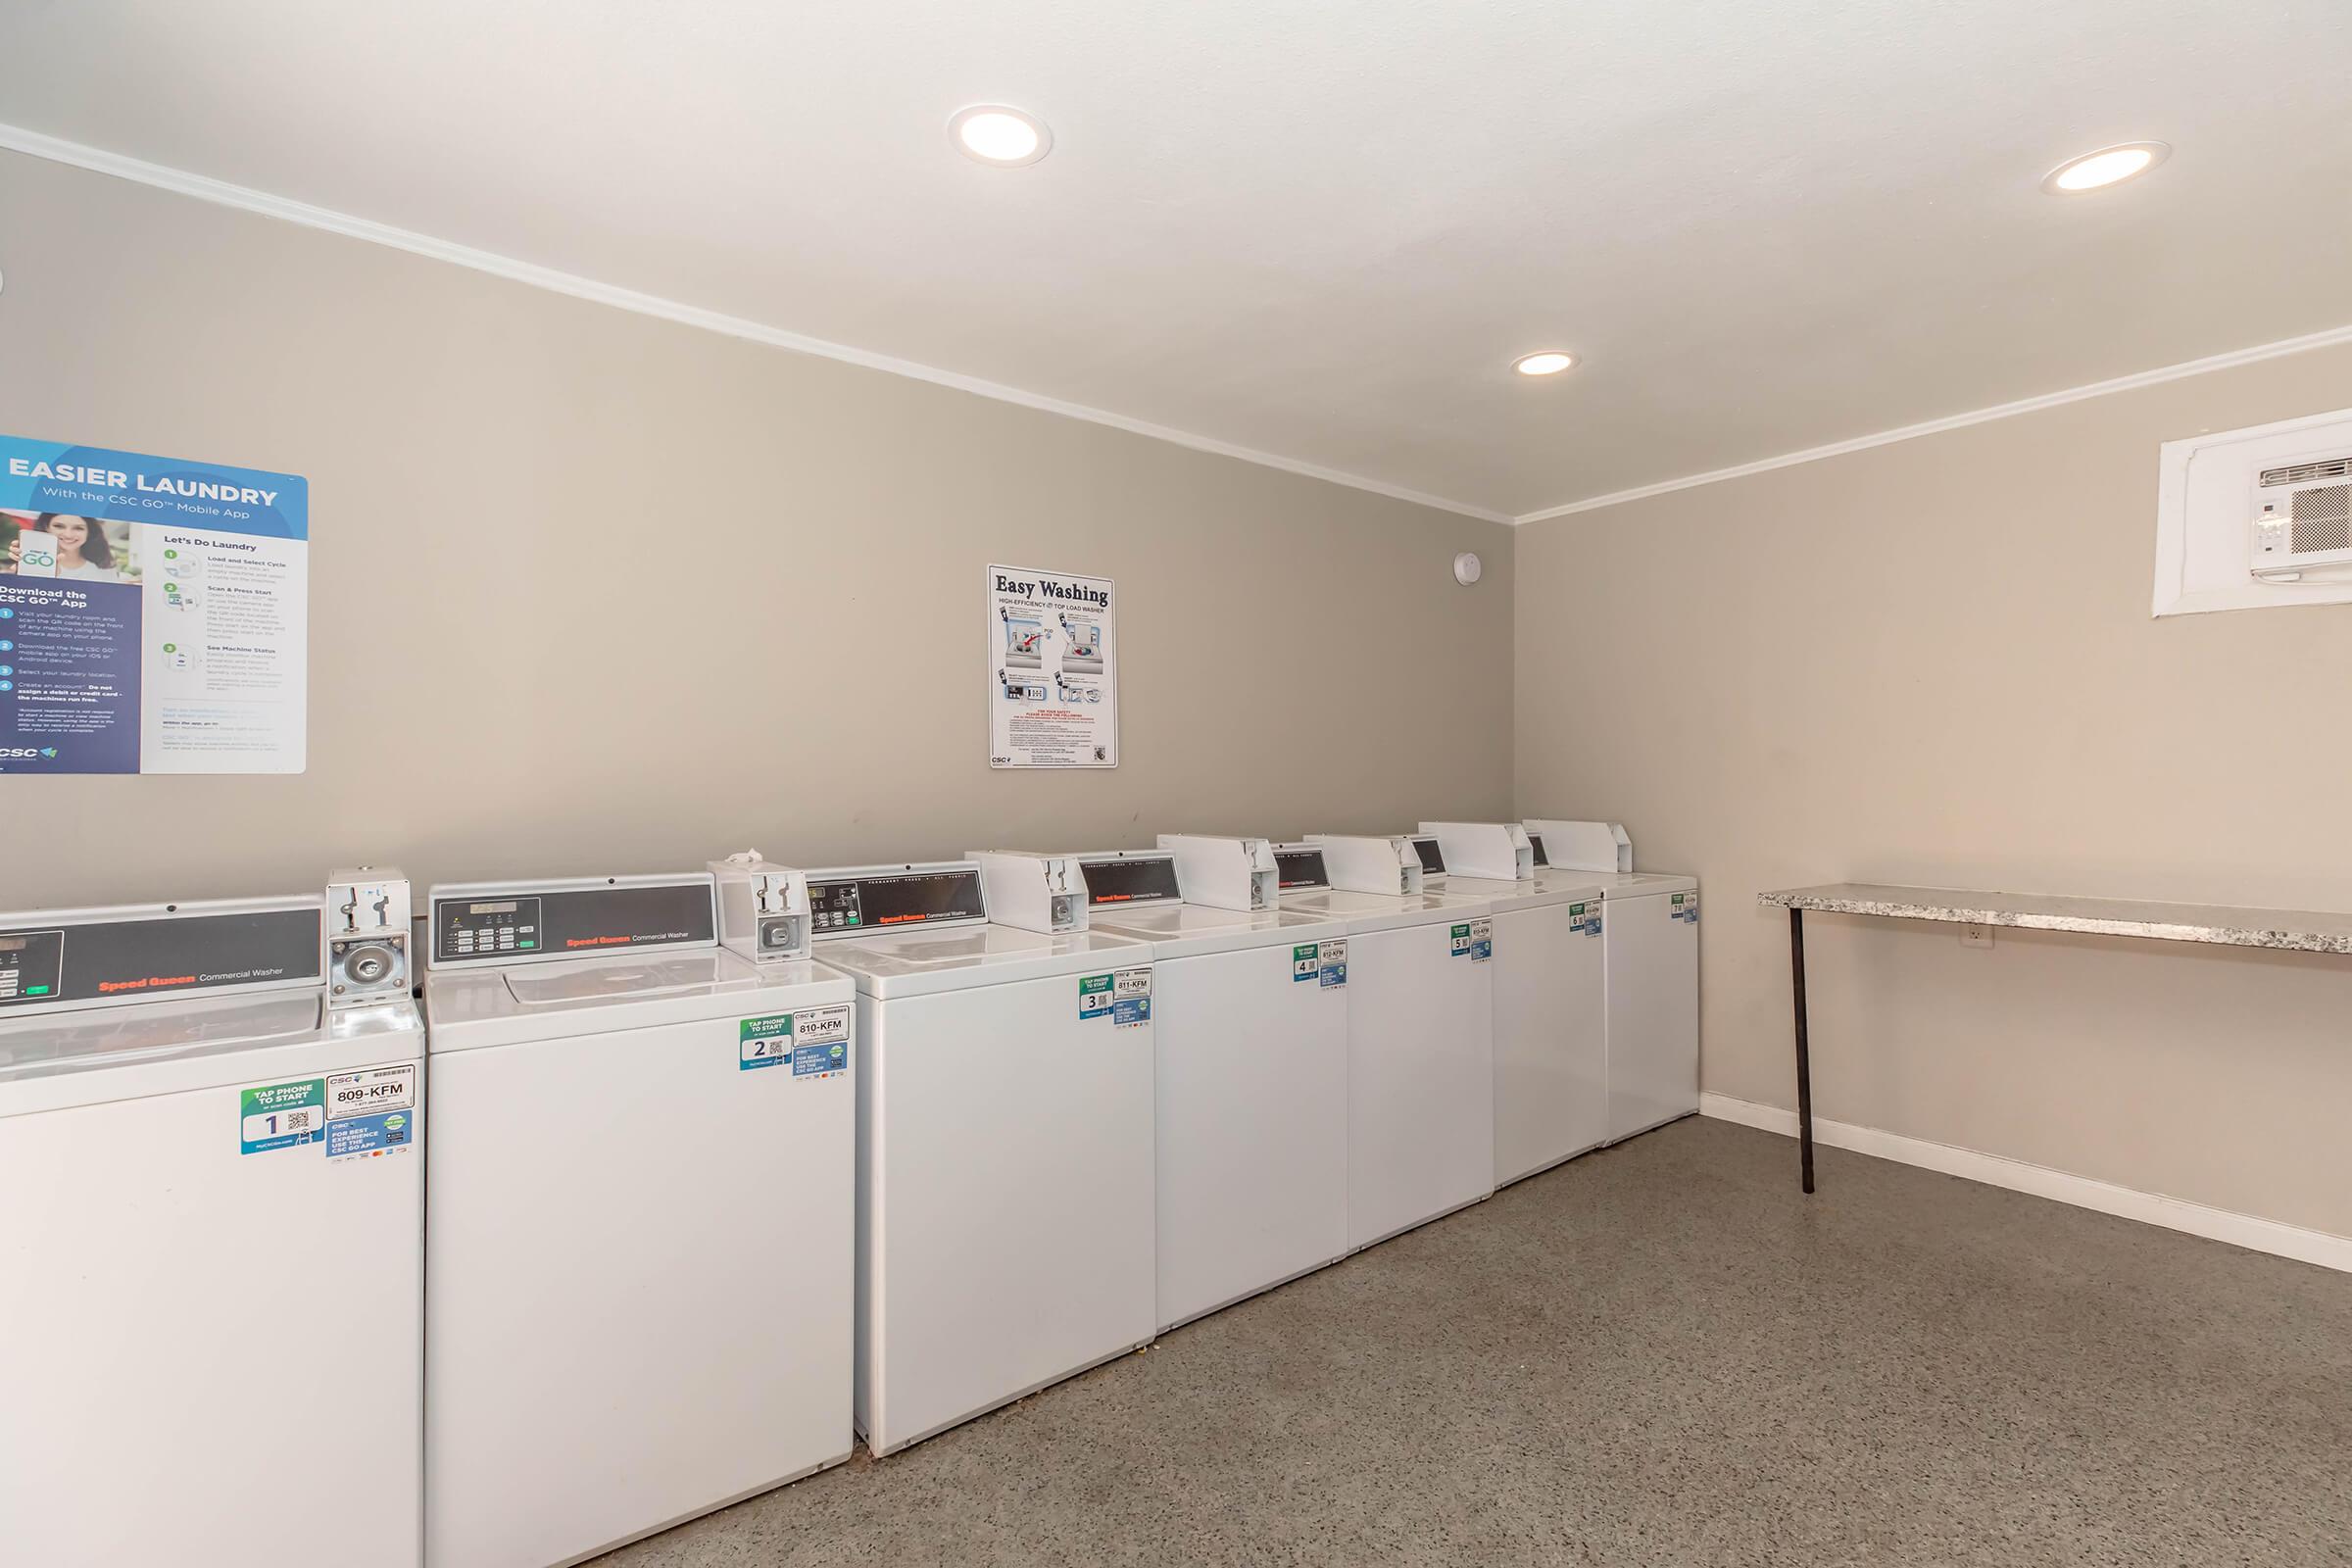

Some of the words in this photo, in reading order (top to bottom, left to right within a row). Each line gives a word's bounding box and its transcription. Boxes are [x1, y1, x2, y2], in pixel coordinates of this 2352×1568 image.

[9, 458, 127, 489] EASIER
[136, 473, 278, 507] LAUNDRY
[43, 487, 77, 500] With
[81, 490, 104, 503] the
[109, 495, 138, 507] CSC
[176, 502, 220, 515] Mobile
[223, 508, 251, 520] App
[213, 541, 257, 553] Laundry
[23, 553, 54, 567] GO
[0, 586, 63, 598] Download
[66, 589, 87, 600] the
[995, 574, 1036, 600] Easy
[1039, 579, 1108, 608] Washing
[0, 595, 25, 604] CSC
[61, 599, 87, 609] App
[999, 598, 1046, 609] HIGH-EFFICIENCY
[0, 748, 38, 758] CSC
[565, 938, 598, 948] Speed
[599, 935, 630, 945] Queen
[632, 932, 667, 942] Commercial
[666, 931, 689, 940] Washer
[1455, 939, 1460, 949] 5
[1299, 961, 1306, 972] 4
[98, 979, 147, 993] Speed
[149, 975, 196, 987] Queen
[199, 970, 251, 983] Commercial
[251, 966, 283, 977] Washer
[1118, 980, 1148, 990] 811-KFM
[1088, 995, 1097, 1008] 3
[761, 1023, 782, 1032] START
[799, 1019, 842, 1034] 810-KFM
[754, 1041, 765, 1056] 2
[329, 1076, 353, 1085] CSC
[254, 1090, 275, 1100] TAP
[276, 1084, 314, 1096] PHONE
[259, 1097, 273, 1105] TO
[275, 1091, 310, 1102] START
[337, 1083, 403, 1102] 809-KFM
[266, 1114, 277, 1135] 1
[331, 1131, 379, 1144] EXPERIENCE
